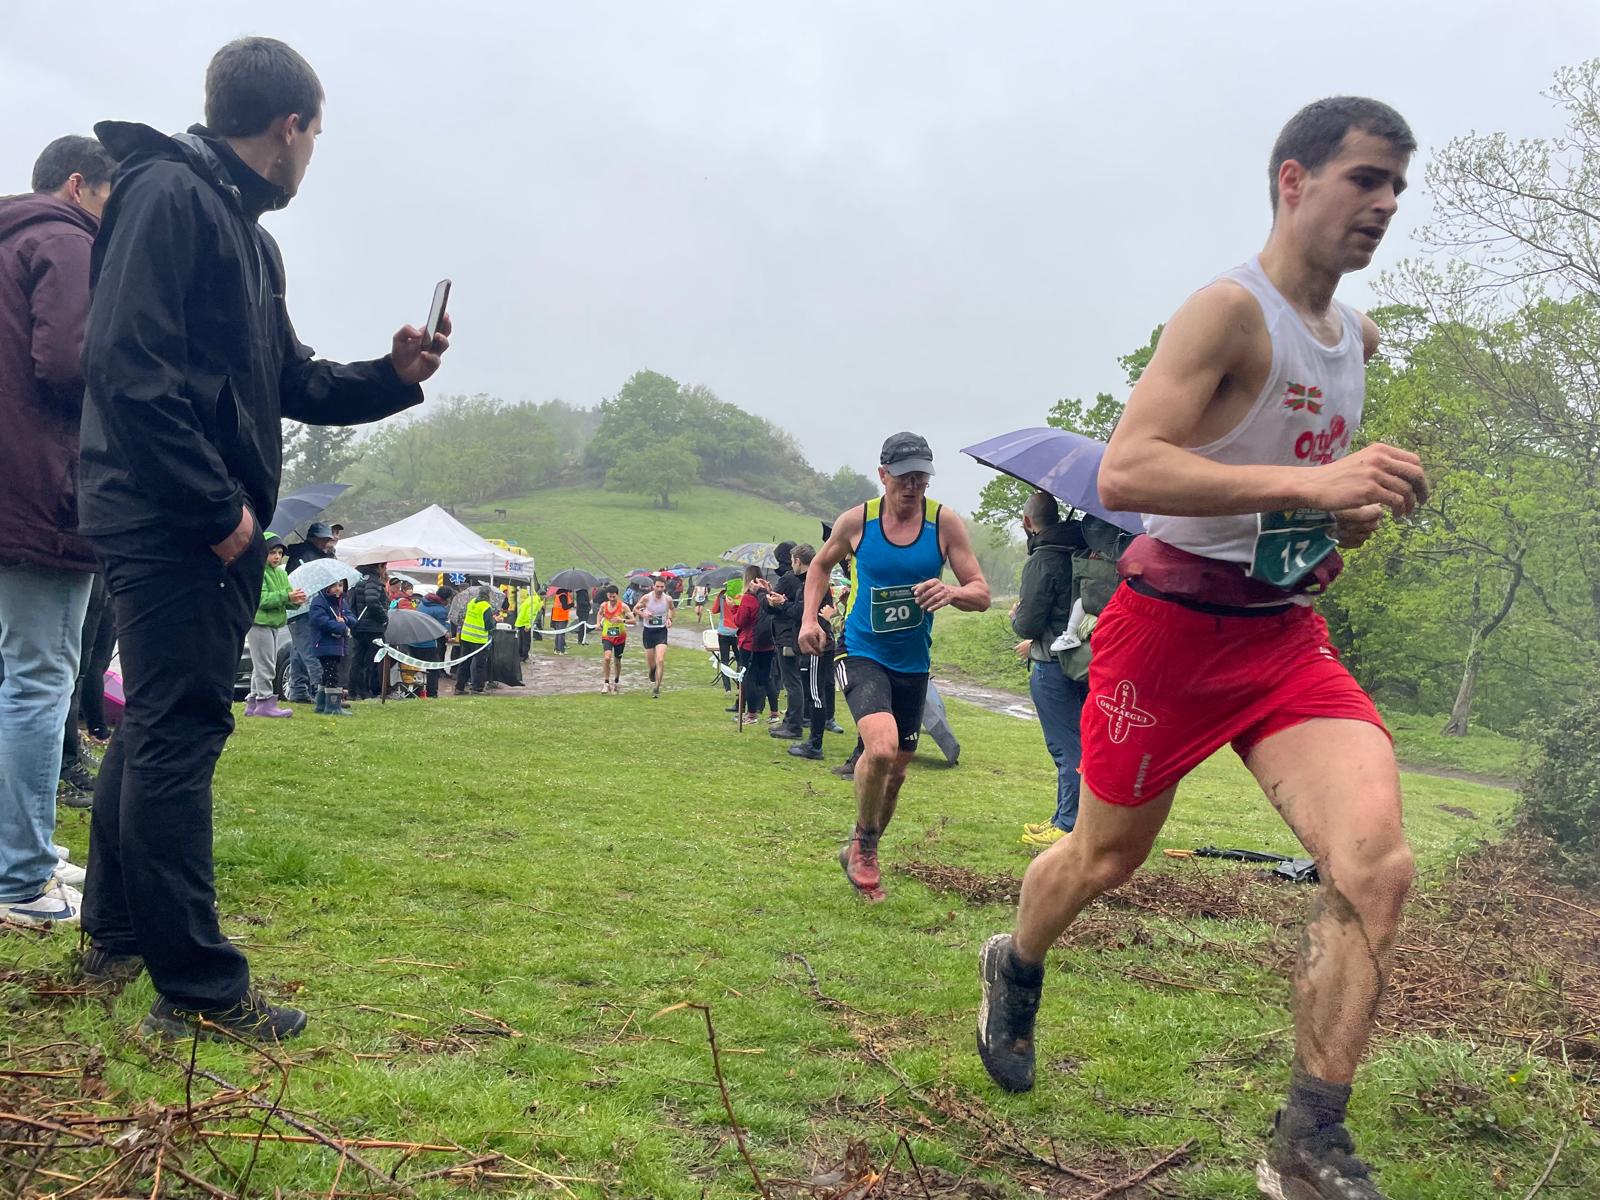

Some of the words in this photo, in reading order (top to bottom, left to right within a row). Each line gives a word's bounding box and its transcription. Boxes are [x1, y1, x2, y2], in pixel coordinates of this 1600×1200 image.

[1281, 540, 1311, 573] 17
[884, 605, 910, 623] 20
[1100, 698, 1148, 724] ORIZAEGUI
